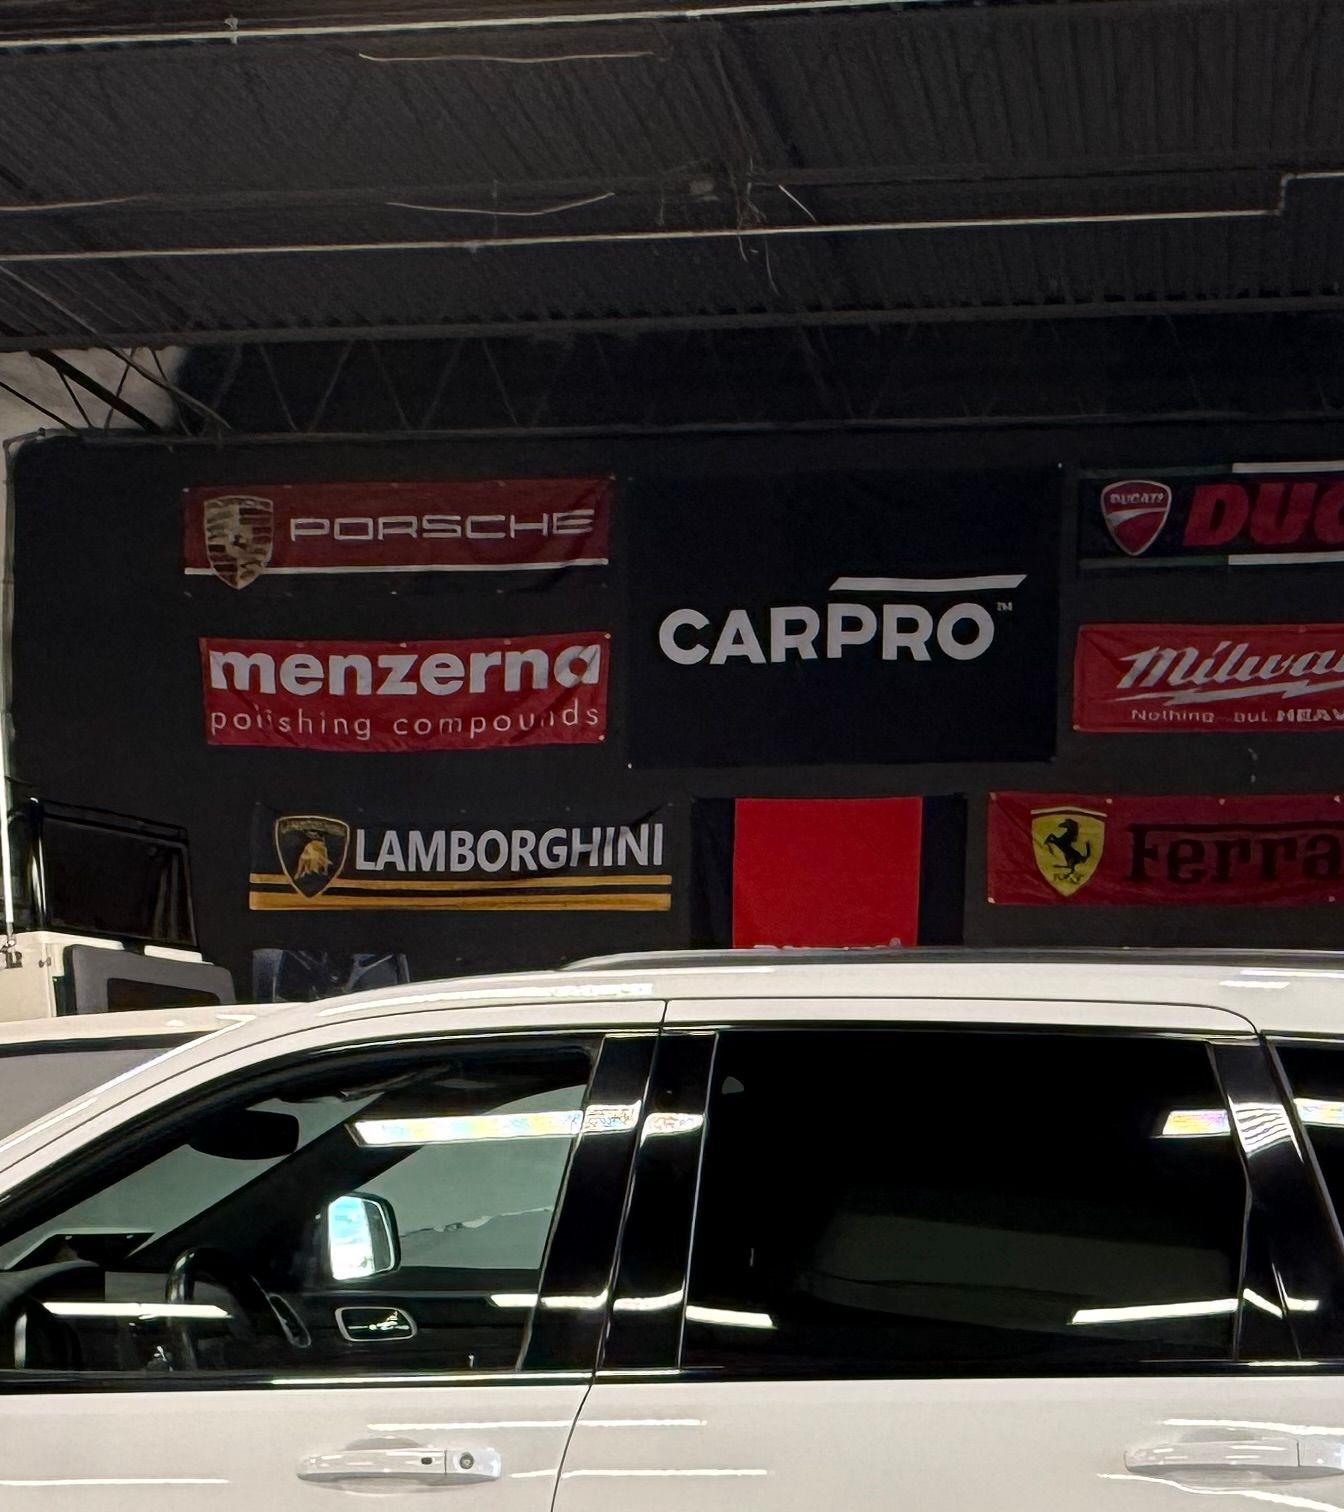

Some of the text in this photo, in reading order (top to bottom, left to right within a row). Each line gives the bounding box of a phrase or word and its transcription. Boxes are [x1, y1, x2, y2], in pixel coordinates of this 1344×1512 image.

[289, 508, 596, 542] PORSCHE
[658, 602, 995, 665] CARPRO
[208, 644, 602, 696] menzerna
[211, 698, 600, 740] polishing compounds
[355, 823, 664, 873] LAMBORGHINI
